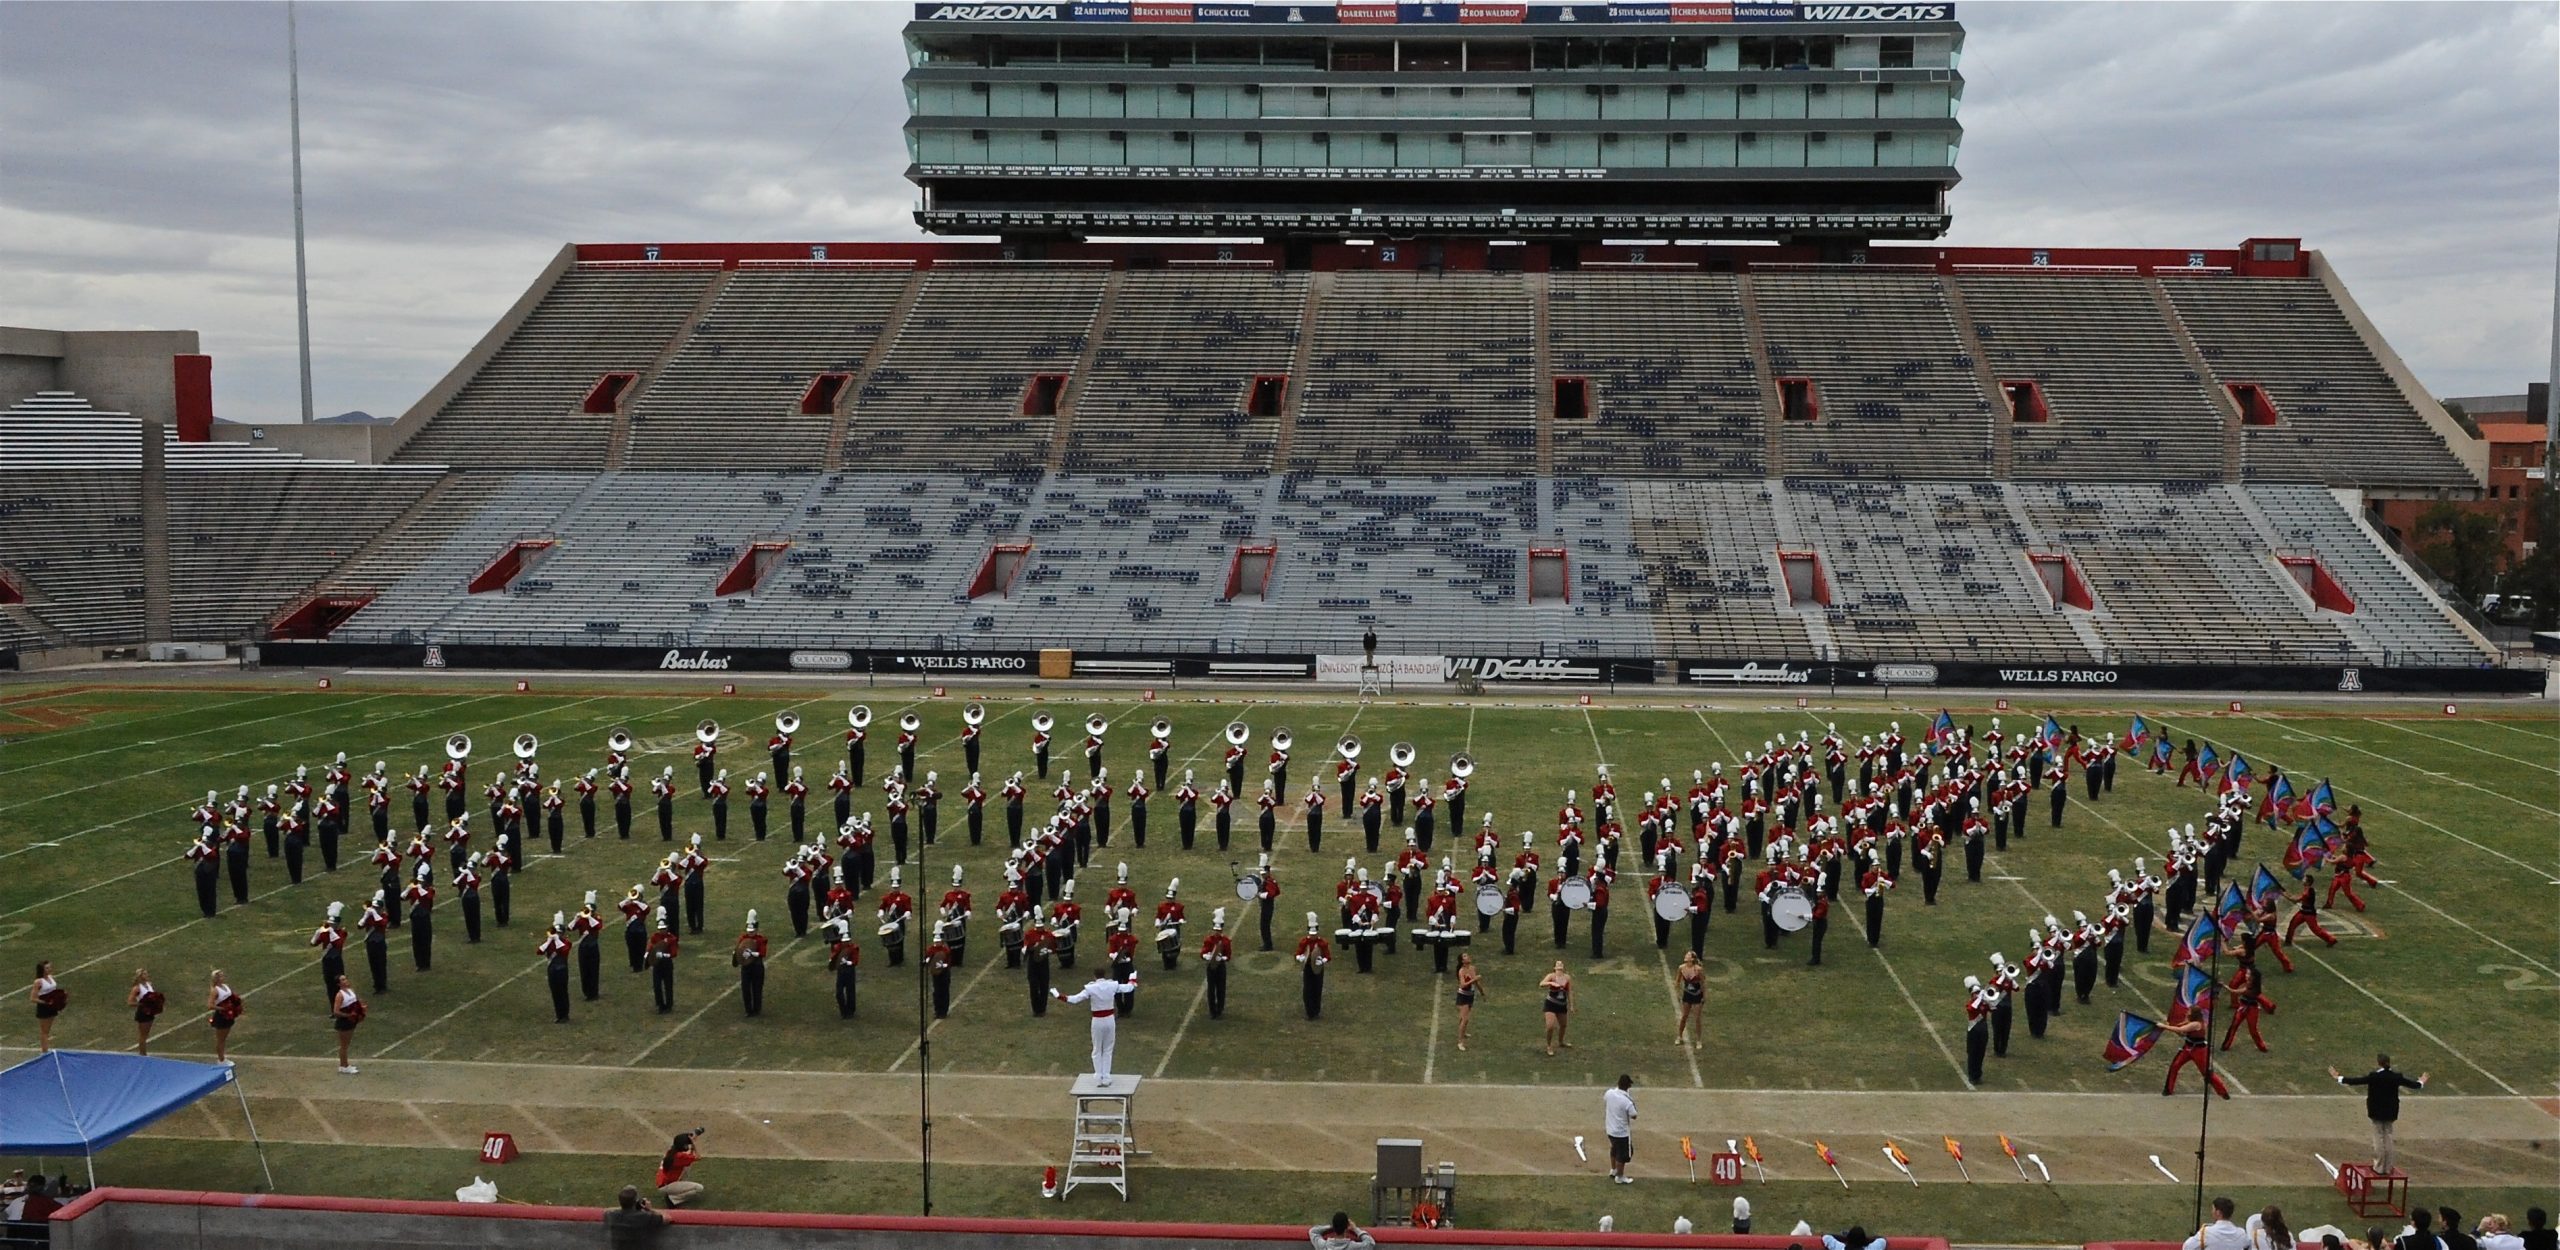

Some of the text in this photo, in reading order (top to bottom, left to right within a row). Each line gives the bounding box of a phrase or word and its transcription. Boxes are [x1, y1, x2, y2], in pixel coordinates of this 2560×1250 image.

[929, 5, 1057, 20] ARIZONA
[1074, 7, 1129, 16] 22 ART LUPPINO
[1143, 8, 1164, 16] RICKY
[1165, 8, 1192, 16] HUNLEY
[1204, 8, 1228, 16] CHUCK
[1337, 10, 1342, 18] 4
[1460, 8, 1520, 17] 92 ROB WALDROP
[1618, 8, 1634, 16] STEVE
[1671, 8, 1732, 16] 11 CHRIS McALISTER
[1740, 8, 1768, 16] ANTOINE
[1769, 8, 1794, 16] CASON
[1804, 6, 1947, 20] WILDCATS
[647, 252, 657, 260] 17
[813, 251, 825, 260] 18
[1003, 251, 1015, 260] 19
[1218, 251, 1232, 261] 20
[1383, 252, 1395, 261] 21
[1631, 253, 1644, 262] 22
[1852, 254, 1865, 264] 23
[2034, 256, 2048, 265] 24
[2189, 258, 2203, 267] 25
[253, 430, 264, 438] 16
[660, 650, 732, 669] Bashas'
[911, 657, 1026, 669] WELLS FARGO
[1320, 663, 1358, 673] UNIVERSITY
[1404, 663, 1424, 673] BAND
[1426, 663, 1440, 673] DAY
[1999, 670, 2118, 683] WELLS FARGO
[484, 1137, 504, 1159] 40
[1716, 1158, 1736, 1180] 40
